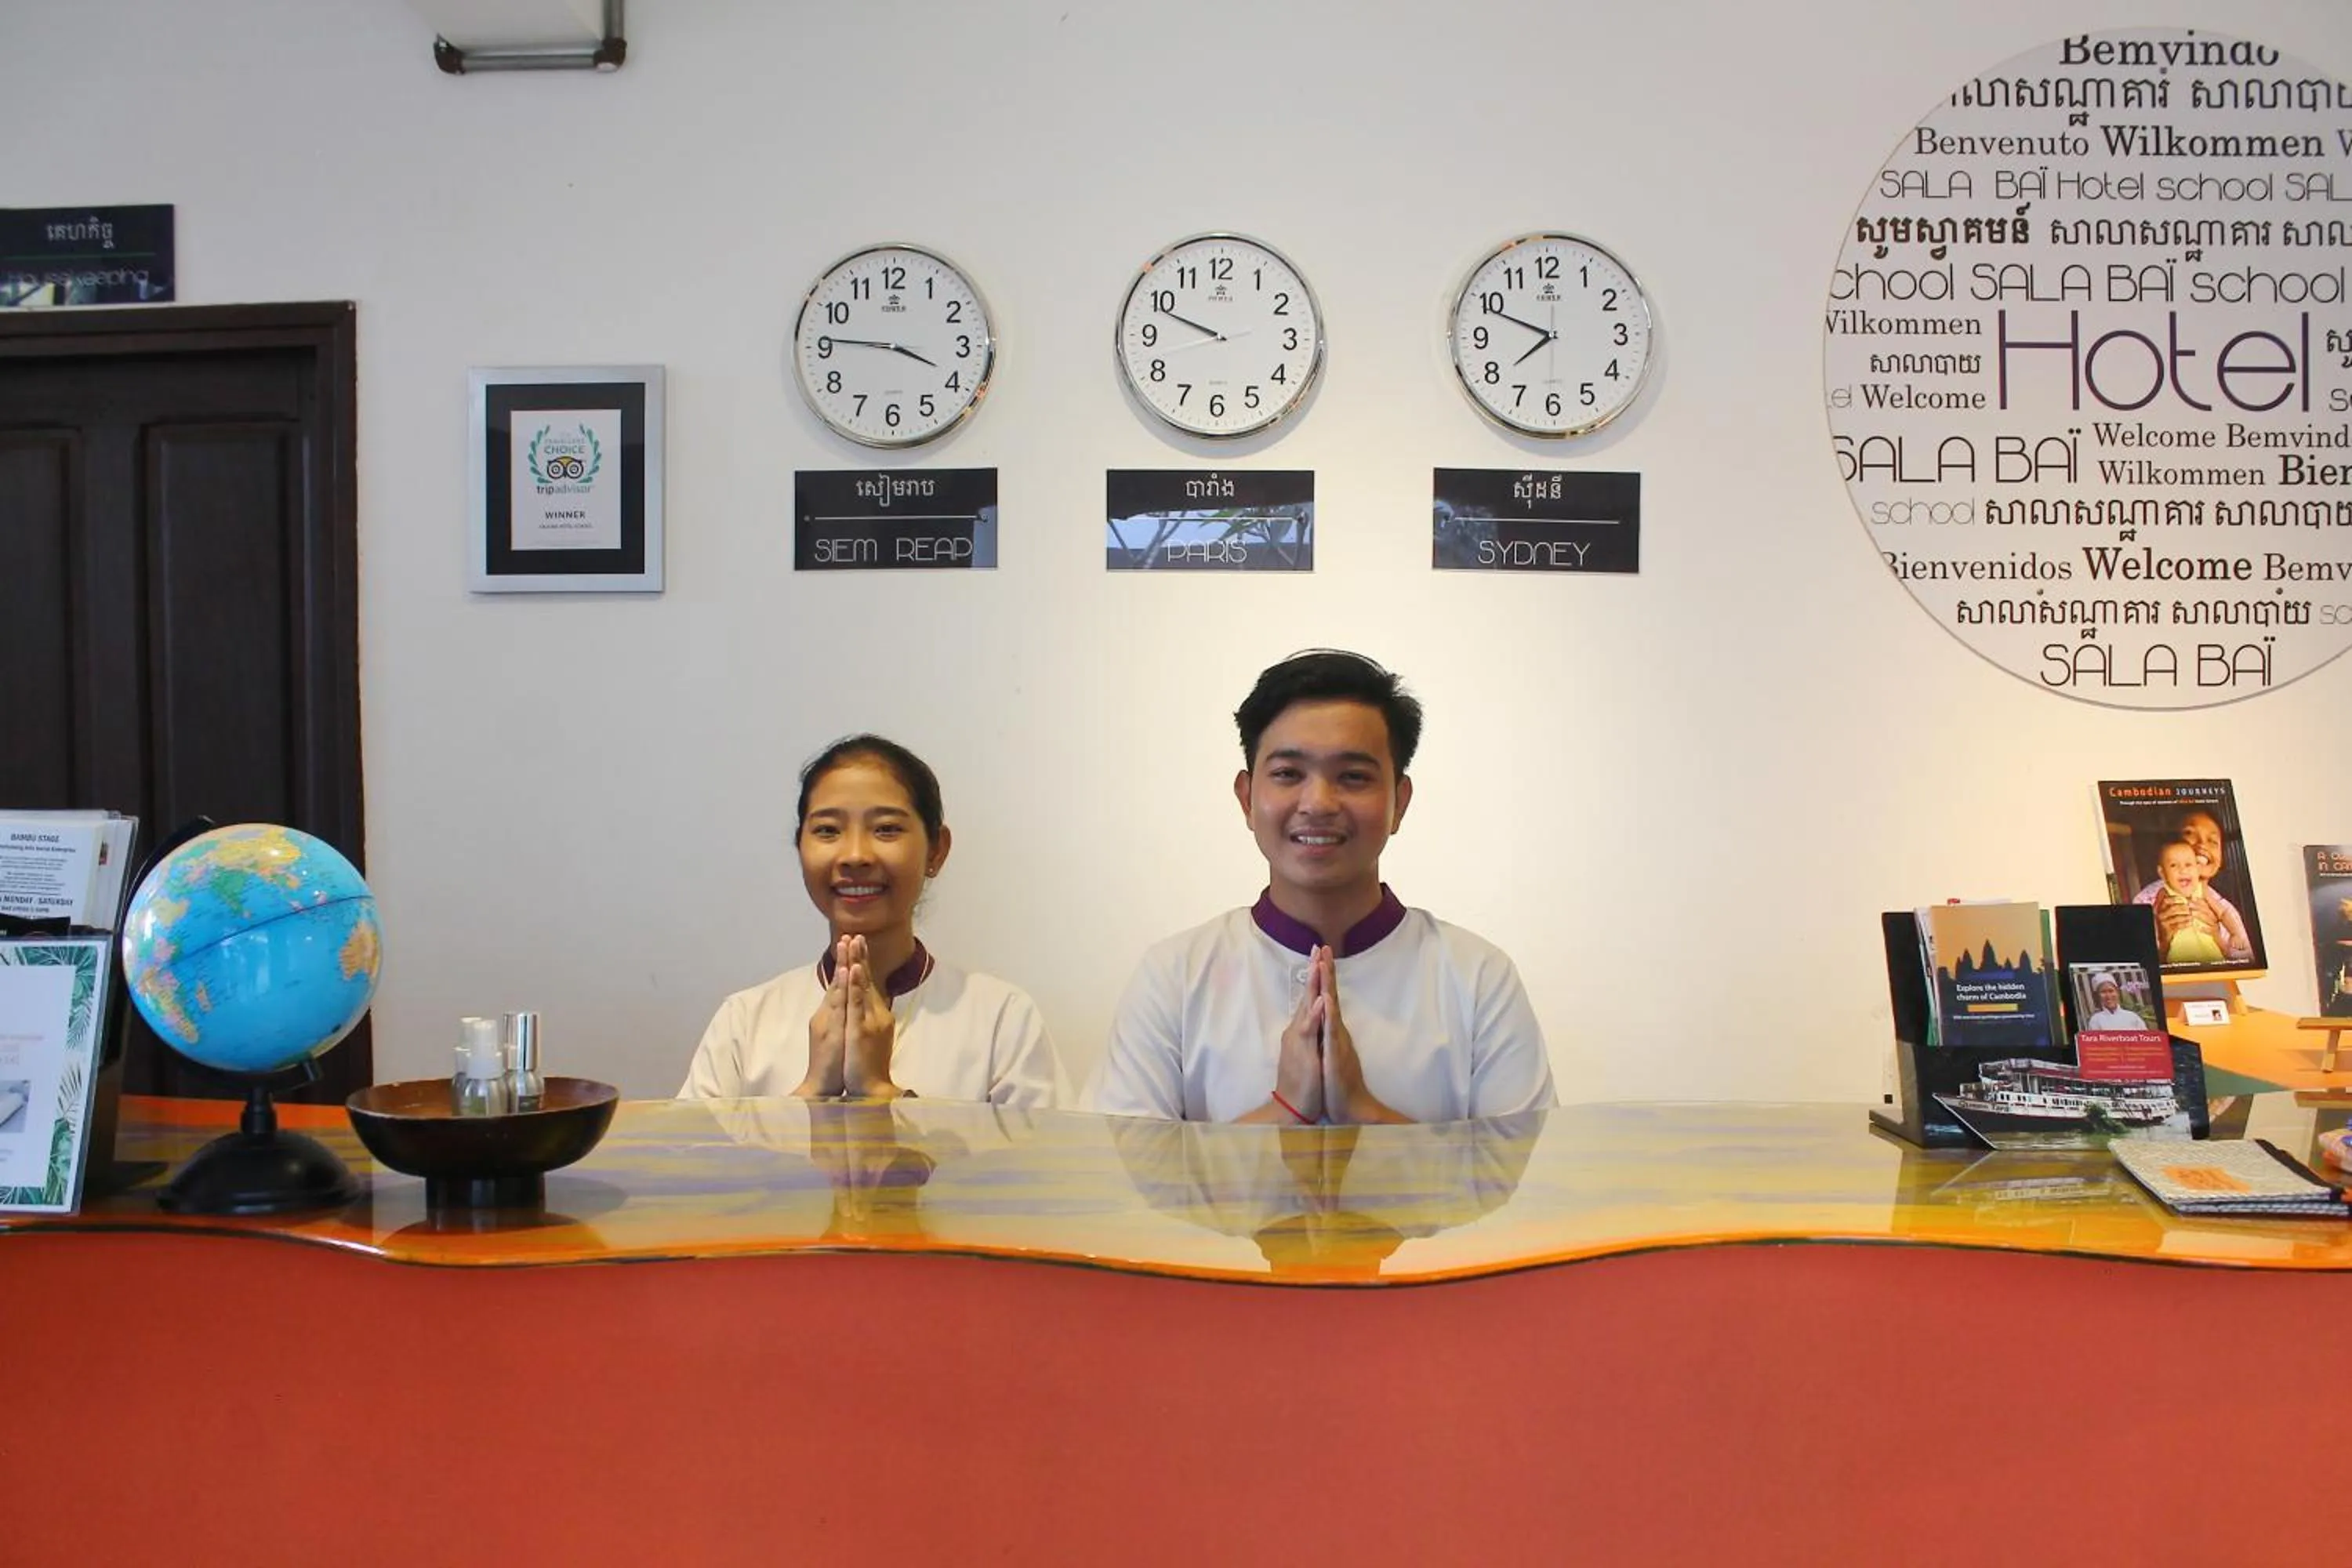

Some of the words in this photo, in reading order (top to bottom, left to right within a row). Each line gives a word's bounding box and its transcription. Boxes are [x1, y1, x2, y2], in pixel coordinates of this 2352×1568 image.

[1914, 125, 2089, 157] Benvenuto
[2099, 125, 2326, 158] Wilkommen
[1879, 165, 1973, 200] SALA
[2056, 170, 2145, 201] Hotel
[2155, 172, 2274, 202] school
[880, 266, 906, 291] 12
[1176, 266, 1196, 290] 11
[1208, 256, 1234, 281] 12
[1253, 267, 1261, 292] 1
[1503, 266, 1524, 291] 11
[1534, 256, 1561, 280] 12
[1579, 264, 1588, 289] 1
[850, 277, 870, 301] 11
[924, 276, 934, 300] 1
[1969, 263, 2092, 302] SALA
[2190, 265, 2346, 304] school
[824, 300, 850, 325] 10
[946, 299, 962, 324] 2
[1150, 289, 1176, 314] 10
[1272, 292, 1290, 317] 2
[1479, 291, 1506, 317] 10
[1601, 288, 1618, 312] 2
[955, 334, 971, 359] 3
[1141, 323, 1158, 348] 9
[1282, 327, 1298, 352] 3
[1472, 325, 1490, 350] 9
[1613, 321, 1629, 347] 3
[817, 335, 835, 360] 9
[1149, 358, 1167, 383] 8
[1483, 361, 1501, 385] 8
[1603, 358, 1621, 382] 4
[1997, 308, 2310, 413] Hotel
[826, 370, 843, 394] 8
[944, 369, 961, 394] 4
[1269, 362, 1287, 386] 4
[852, 394, 869, 418] 7
[918, 393, 935, 419] 5
[1176, 383, 1192, 407] 7
[1209, 394, 1225, 419] 6
[1243, 385, 1261, 409] 5
[1511, 383, 1528, 408] 7
[1544, 392, 1562, 417] 6
[1579, 382, 1596, 407] 5
[1859, 383, 1986, 410] Welcome
[884, 403, 901, 428] 6
[2091, 422, 2216, 448] Welcome
[544, 445, 585, 455] CHOICE
[2096, 459, 2267, 486] Wilkommen
[536, 485, 591, 495] tripadvisor
[545, 510, 586, 519] WINNER
[1870, 495, 1976, 526] school
[814, 538, 878, 562] SIEM
[896, 537, 973, 561] REAP
[1167, 539, 1247, 563] PARIS
[1478, 540, 1590, 566] SYDNEY
[2081, 546, 2253, 582] Welcome
[2040, 644, 2177, 687] SALA
[2109, 786, 2171, 798] Cambodian
[1956, 984, 1984, 993] Explore
[1984, 983, 1996, 992] the
[1956, 993, 1979, 1001] charm
[1989, 991, 2027, 1000] Cambodia
[2082, 1034, 2098, 1043] Tara
[2099, 1033, 2138, 1042] Riverboat
[2139, 1033, 2161, 1042] Tours
